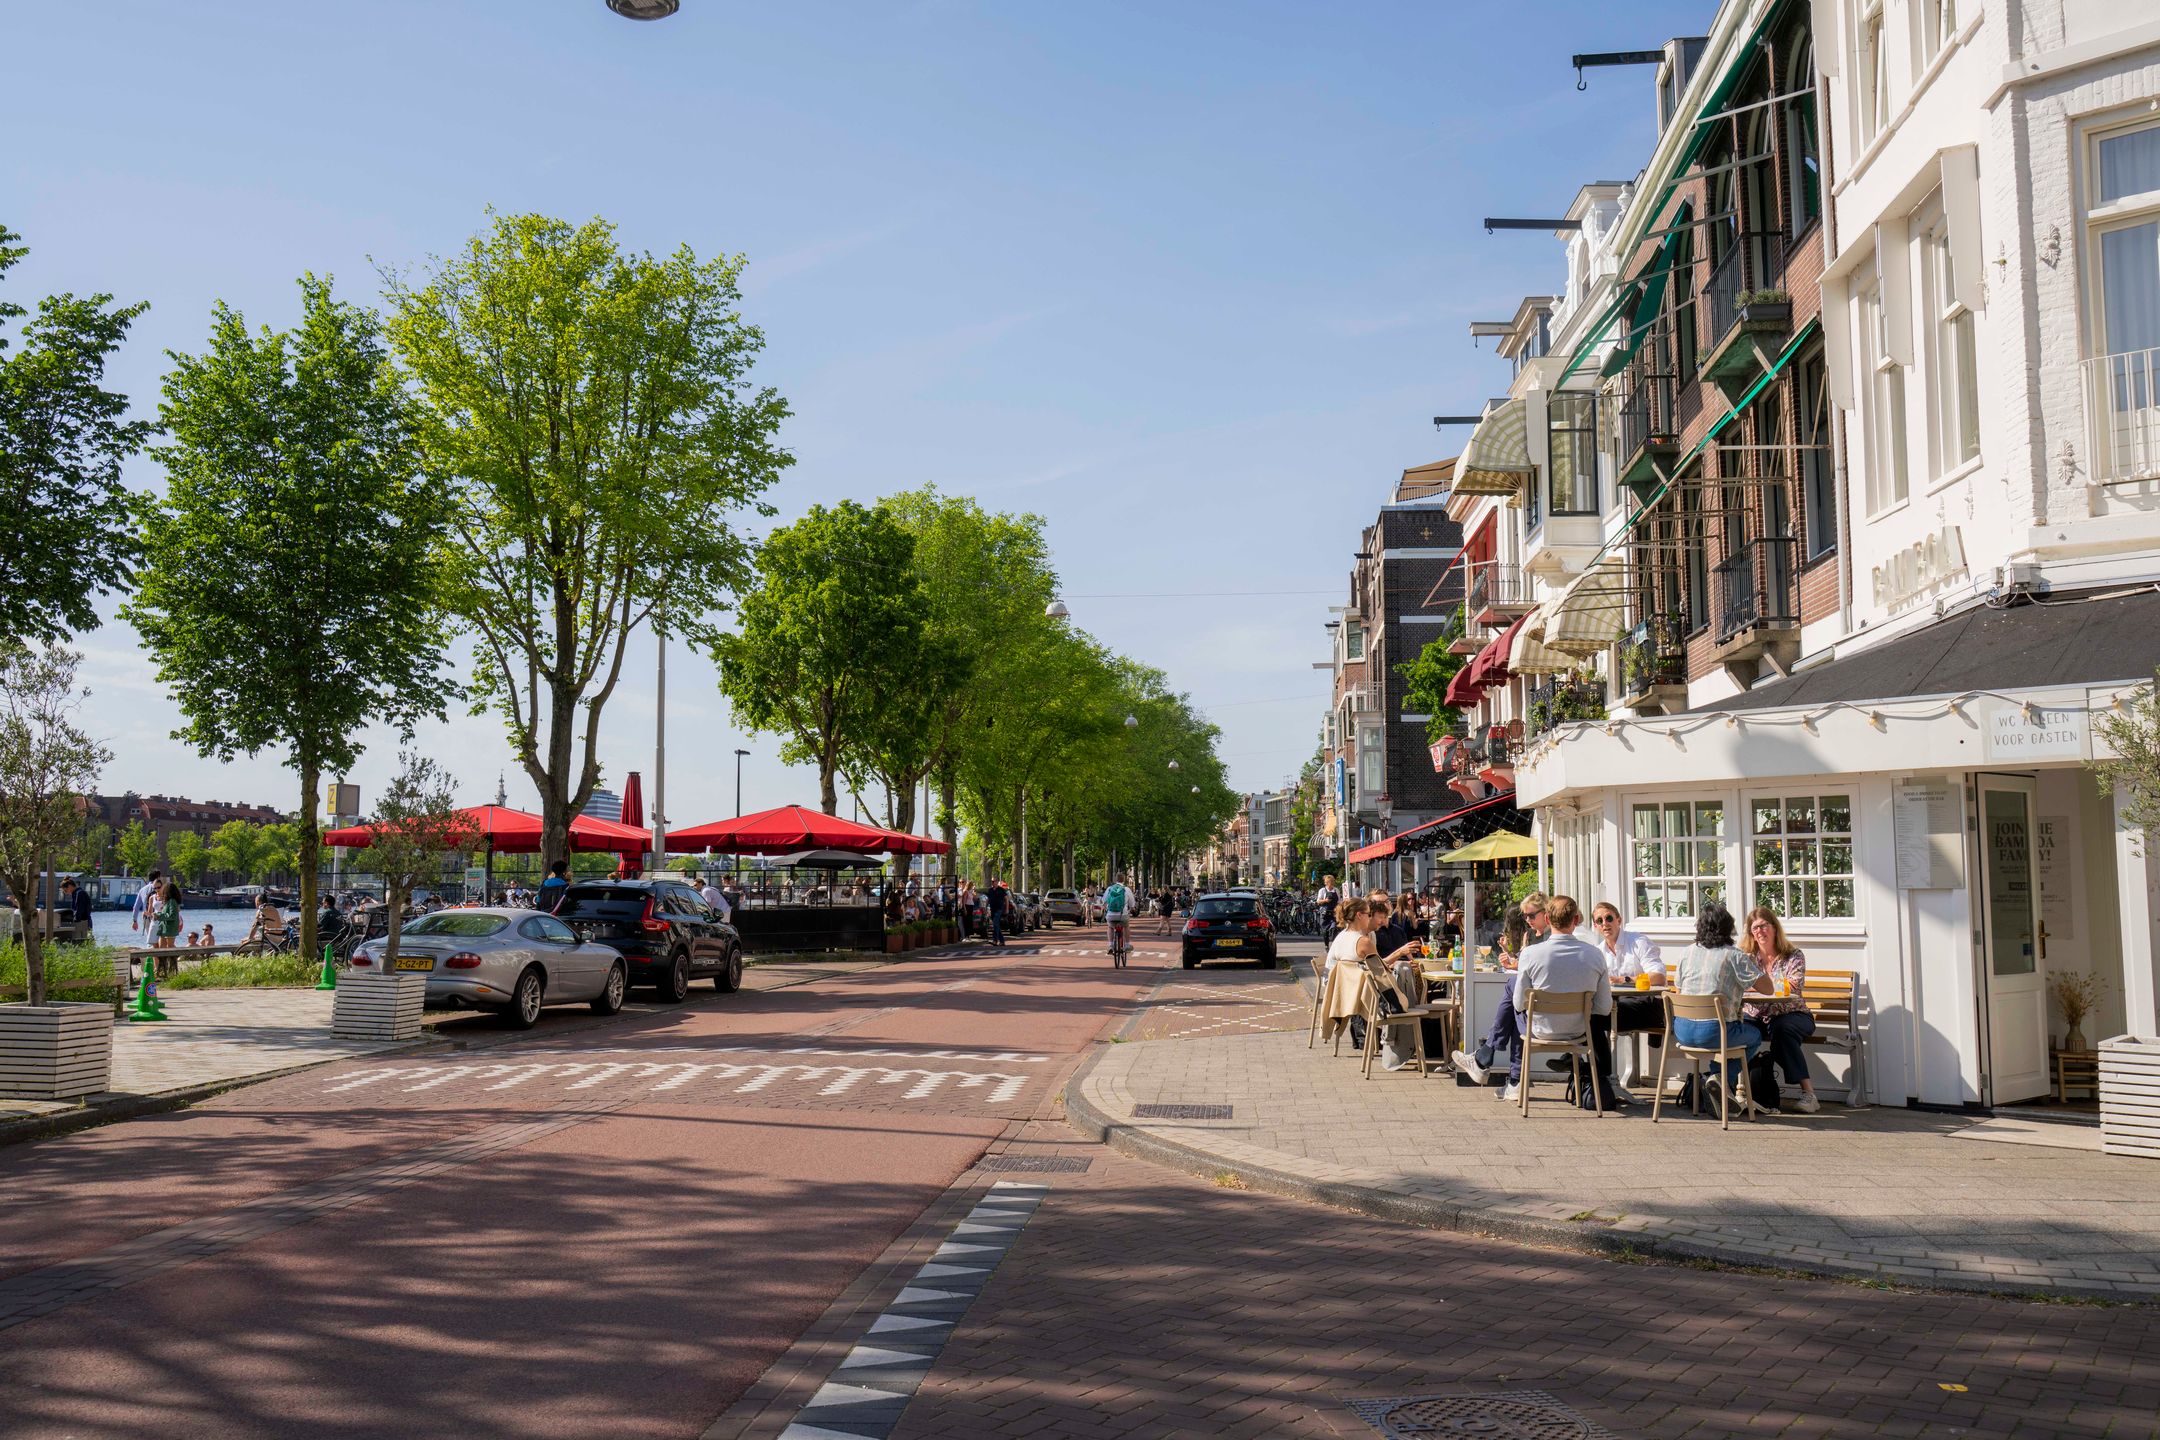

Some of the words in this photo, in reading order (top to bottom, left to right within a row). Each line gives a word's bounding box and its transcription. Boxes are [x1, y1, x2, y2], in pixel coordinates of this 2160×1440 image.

[1998, 715, 2016, 727] WC
[2023, 712, 2070, 727] ALLEEN
[1994, 733, 2025, 746] VOOR
[2031, 731, 2077, 745] GASTEN
[1995, 822, 2024, 835] JOIN
[1995, 836, 2055, 848] BAMOA
[1999, 849, 2051, 861] FAMY!
[395, 960, 429, 968] 2-GZ-PT
